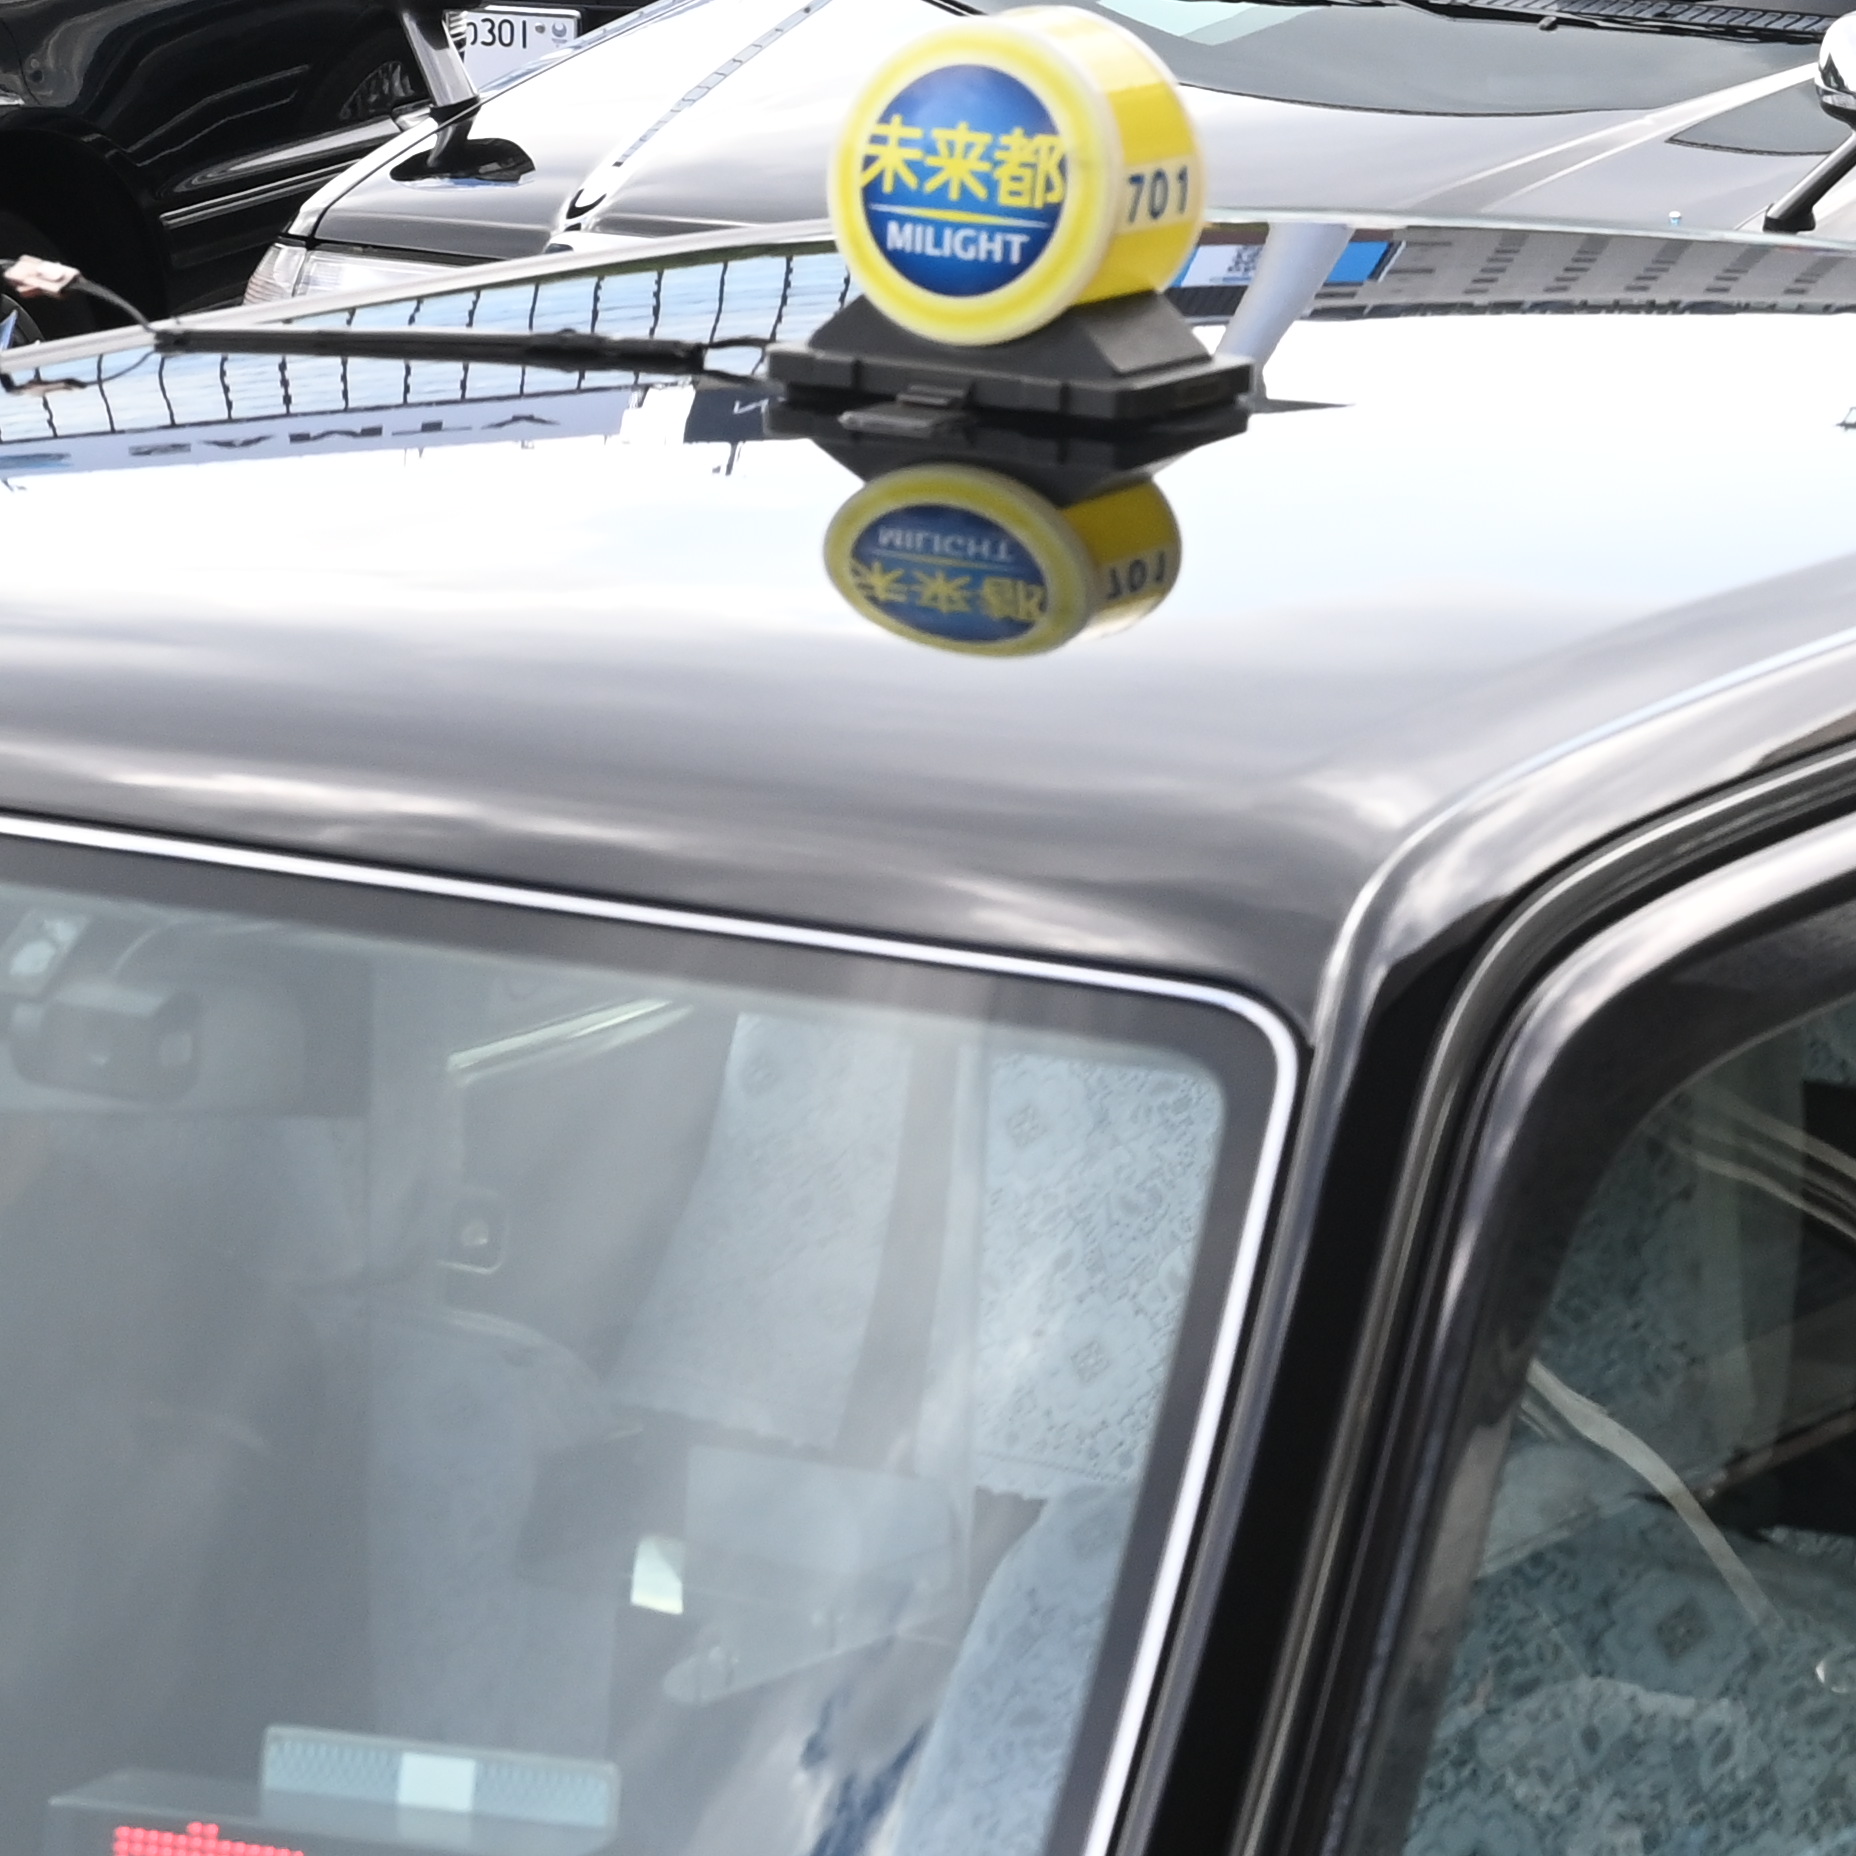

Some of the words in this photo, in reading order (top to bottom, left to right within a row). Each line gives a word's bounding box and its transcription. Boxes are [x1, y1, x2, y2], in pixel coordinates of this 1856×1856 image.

[859, 114, 1069, 210] 未来都
[1126, 164, 1189, 225] 701
[886, 220, 1031, 265] MILIGHT
